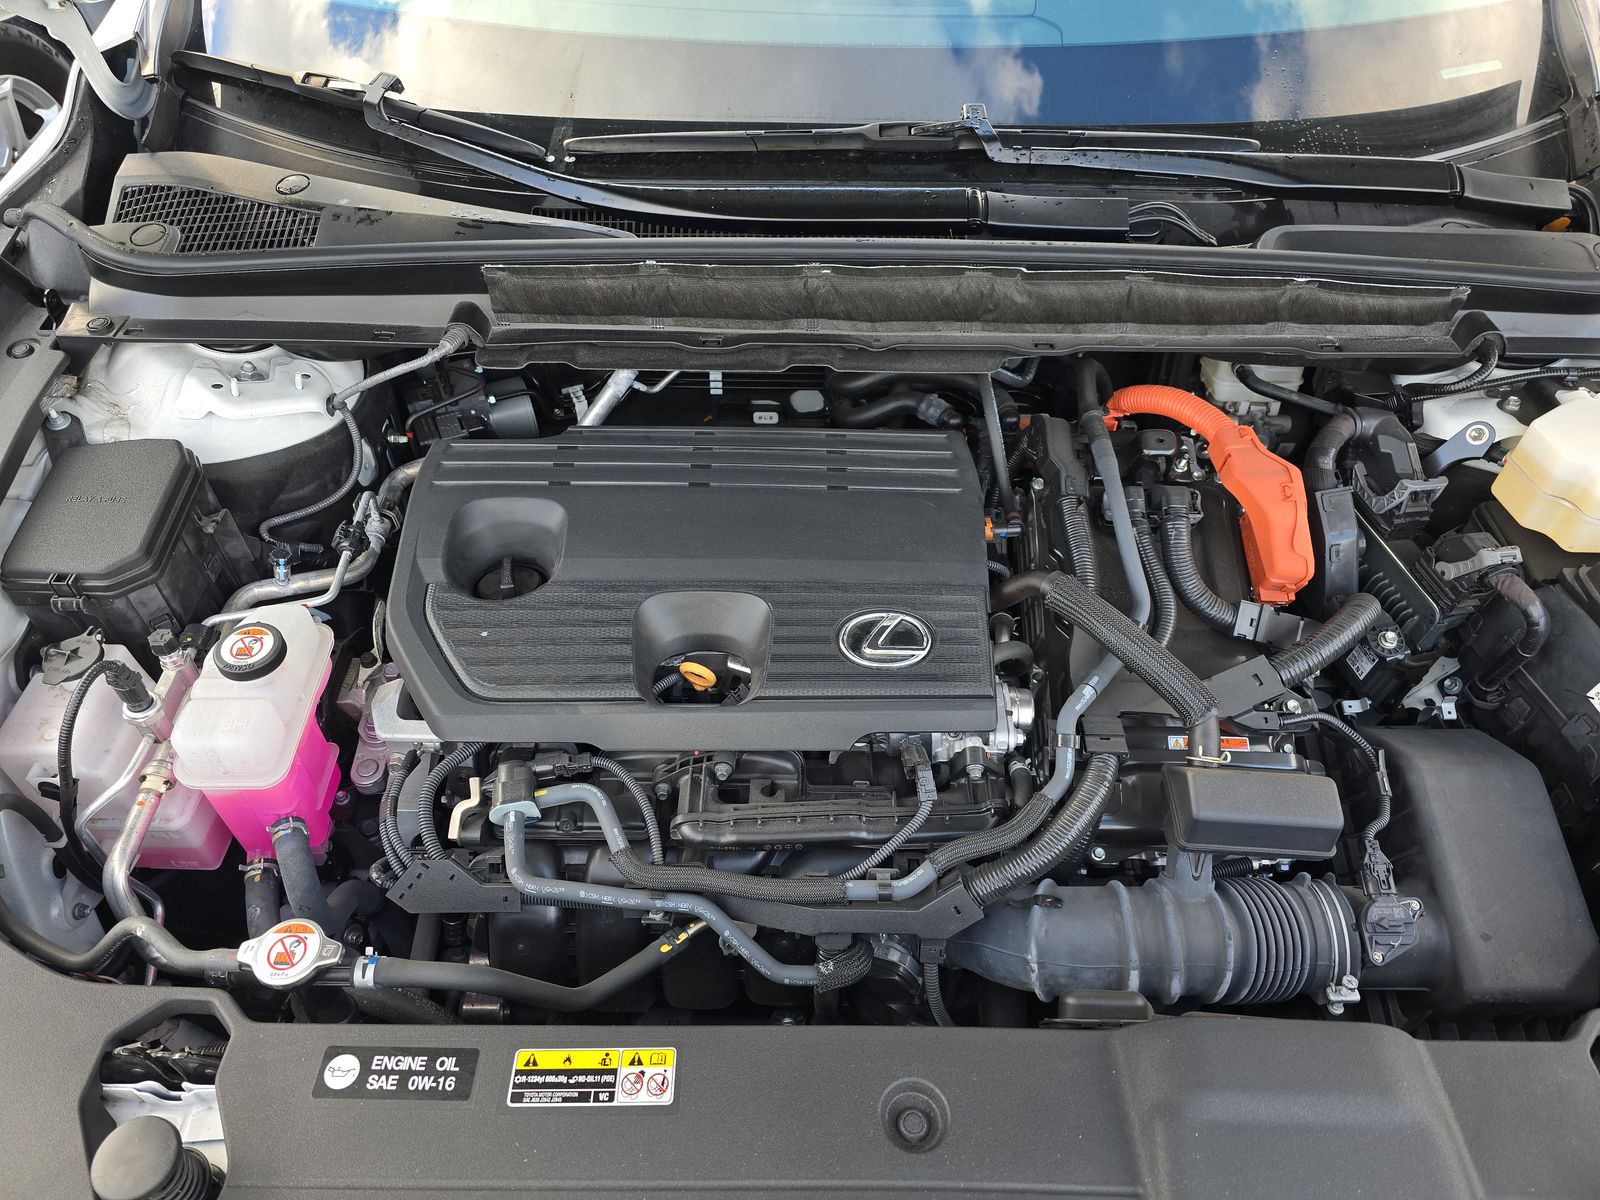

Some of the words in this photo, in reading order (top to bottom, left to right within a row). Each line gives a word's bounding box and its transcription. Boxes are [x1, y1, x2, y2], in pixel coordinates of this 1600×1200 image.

[371, 1056, 428, 1071] ENGINE
[435, 1057, 460, 1071] OIL
[366, 1075, 399, 1090] SAE
[408, 1076, 456, 1091] 0W-16
[599, 1092, 610, 1101] VC
